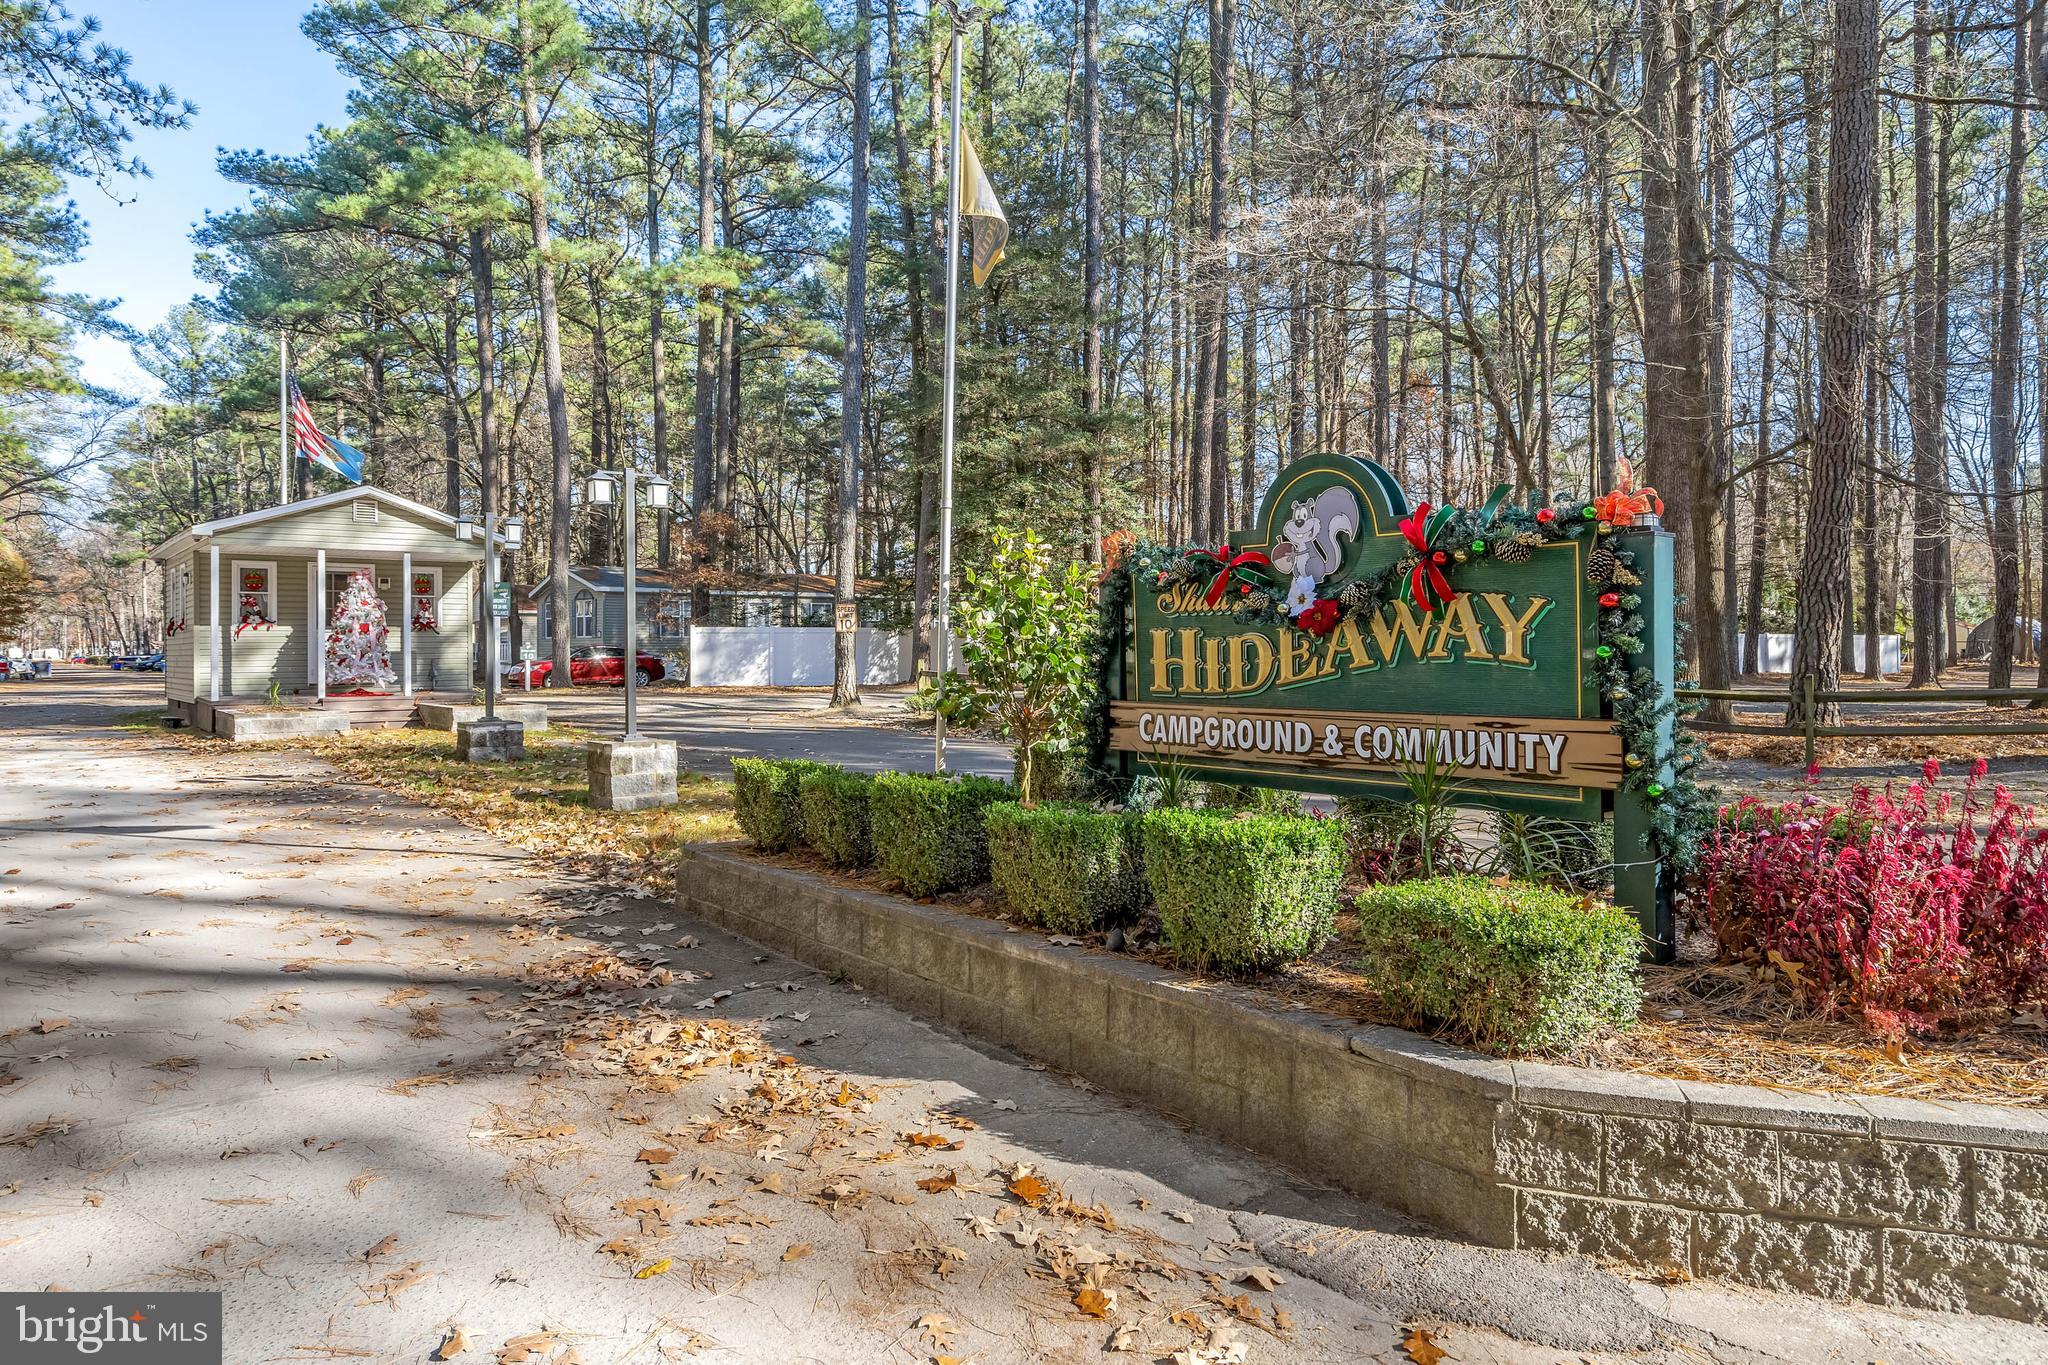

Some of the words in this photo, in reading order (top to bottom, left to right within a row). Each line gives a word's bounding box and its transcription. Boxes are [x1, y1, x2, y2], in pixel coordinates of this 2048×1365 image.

[840, 620, 852, 630] 10
[1149, 591, 1550, 693] HIDEAWAY
[1138, 713, 1313, 753] CAMPGROUND
[1322, 724, 1344, 756] &
[1354, 725, 1566, 772] COMMUNITY
